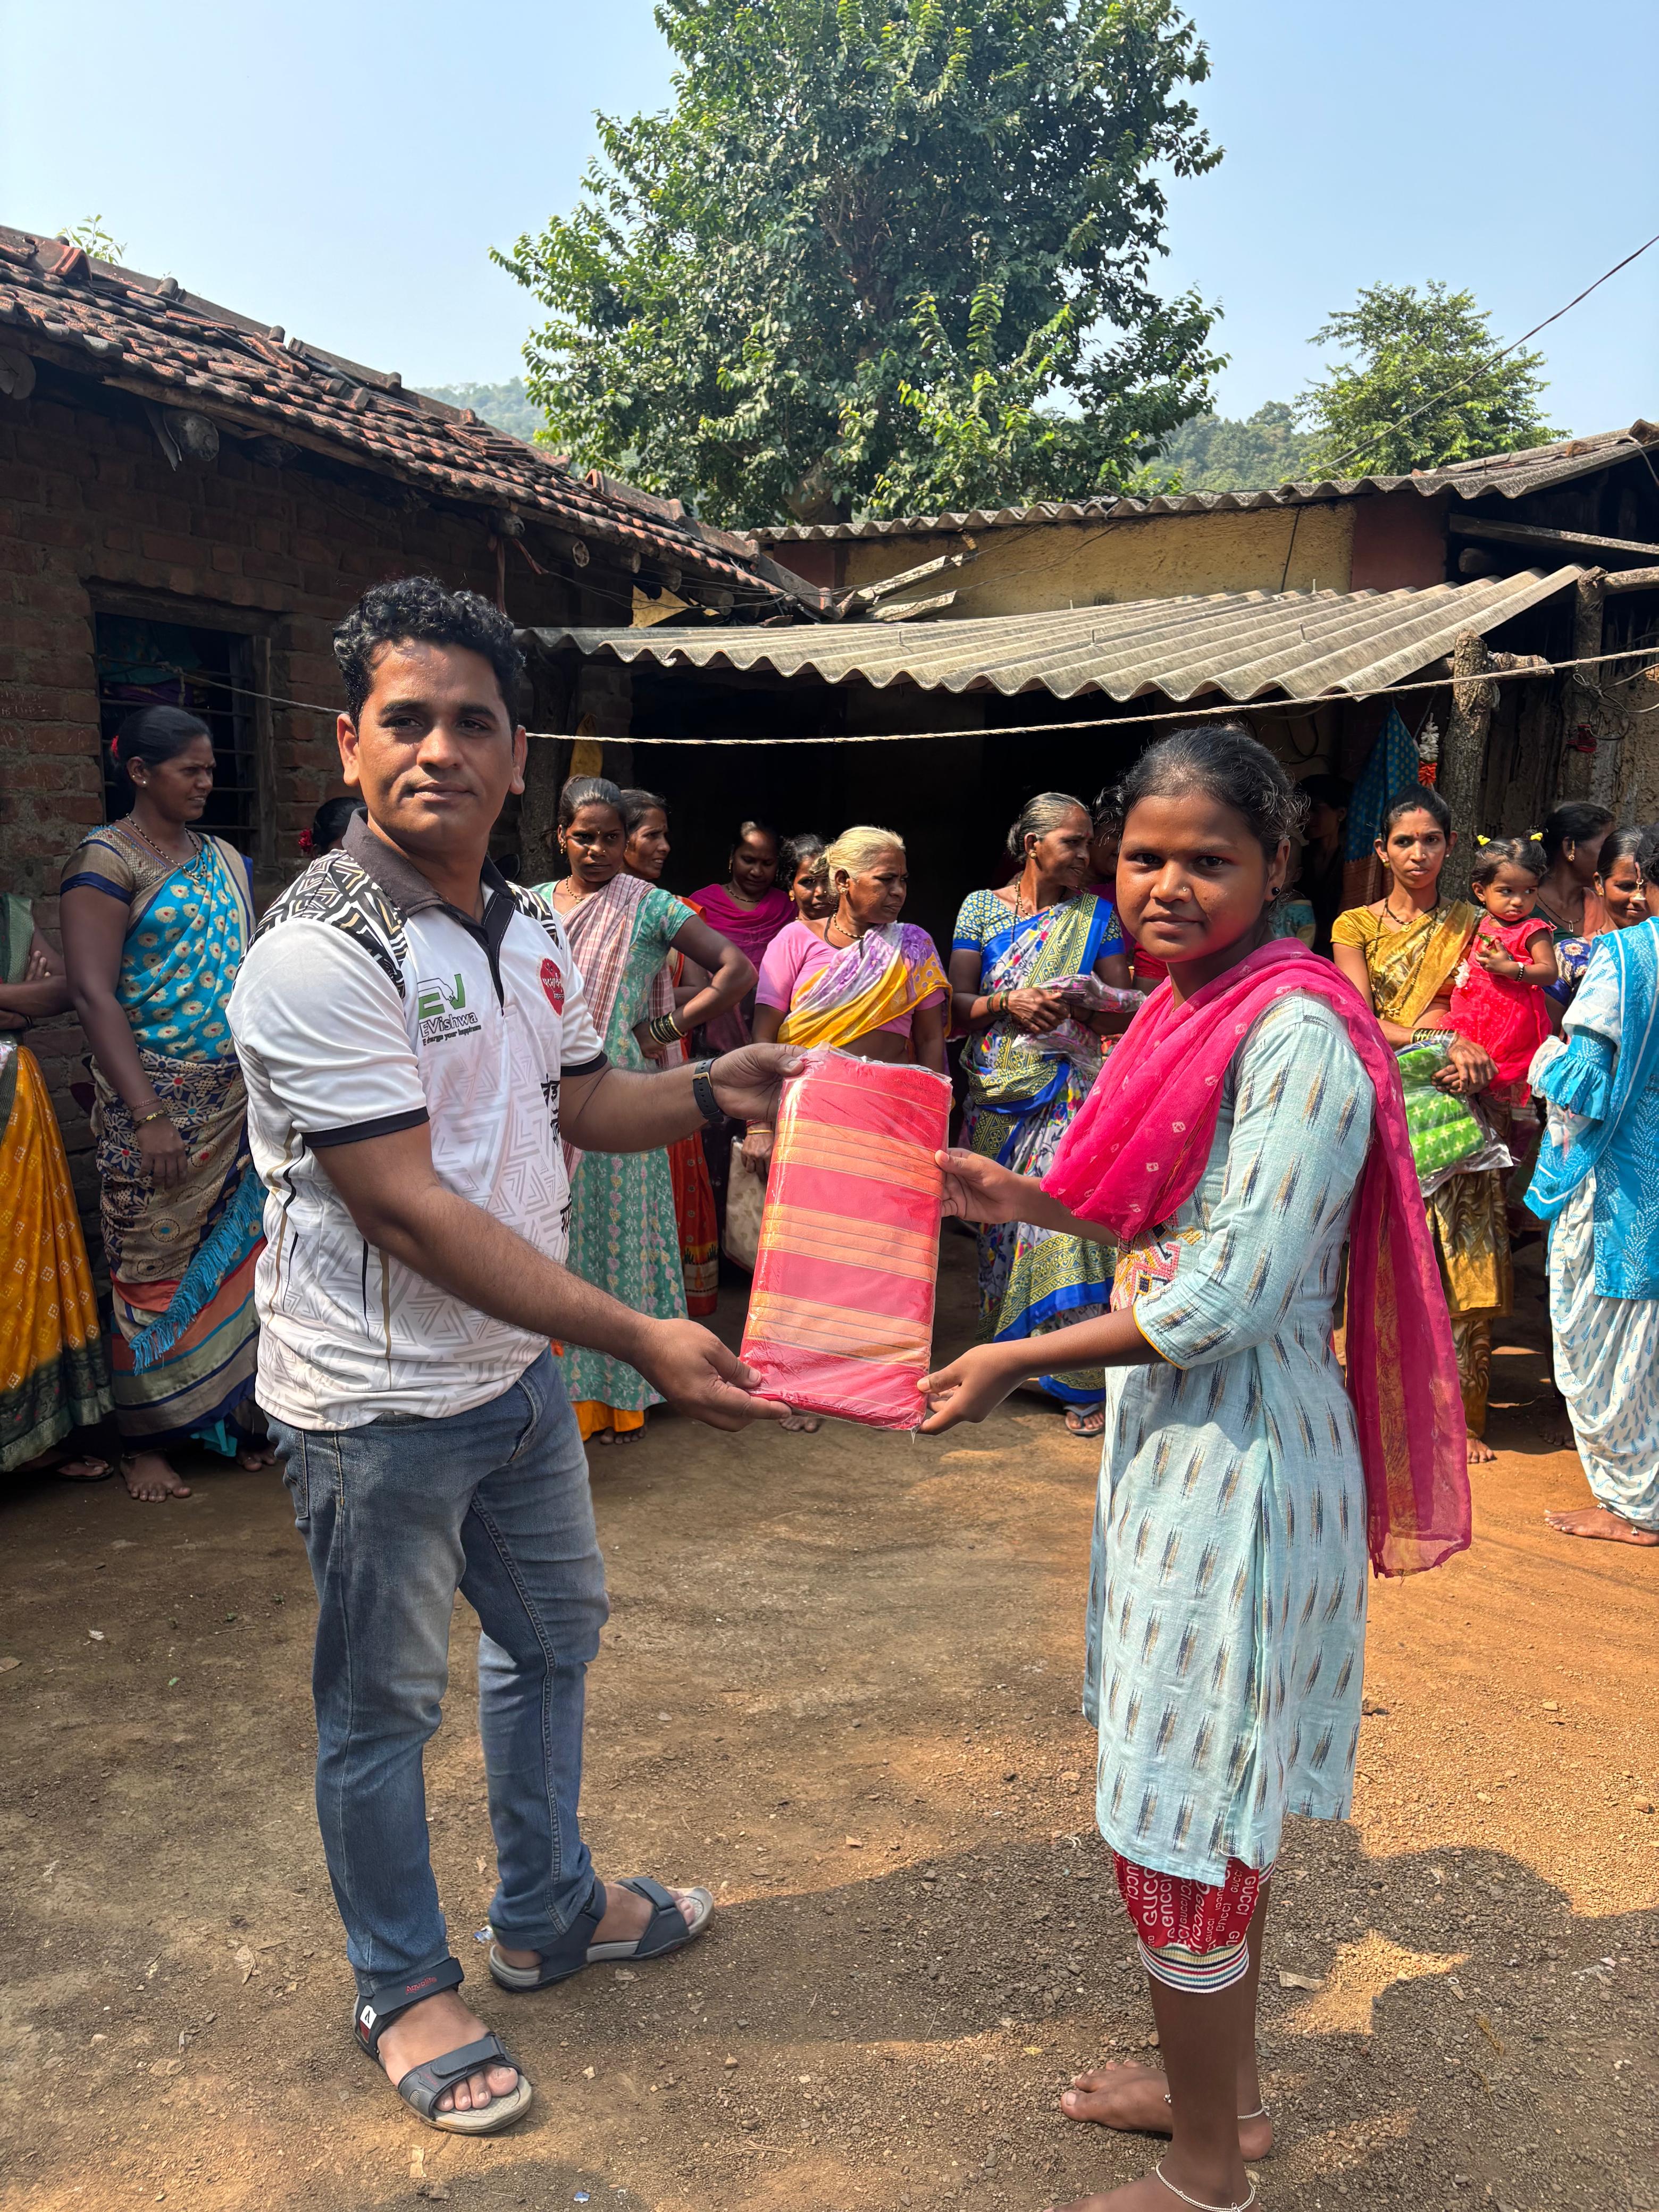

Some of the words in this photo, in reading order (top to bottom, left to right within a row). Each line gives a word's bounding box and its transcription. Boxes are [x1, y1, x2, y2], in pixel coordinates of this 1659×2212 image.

[420, 1012, 478, 1037] EVishwa
[1127, 1862, 1138, 1900] UCCI
[1230, 1869, 1243, 1893] GUCCI
[1236, 1876, 1256, 1915] GUCCI
[1143, 1869, 1158, 1926] GUCC
[1179, 1898, 1188, 1924] GUCCI
[1192, 1893, 1204, 1941] GUCCI
[1205, 1918, 1215, 1942] GUCCI
